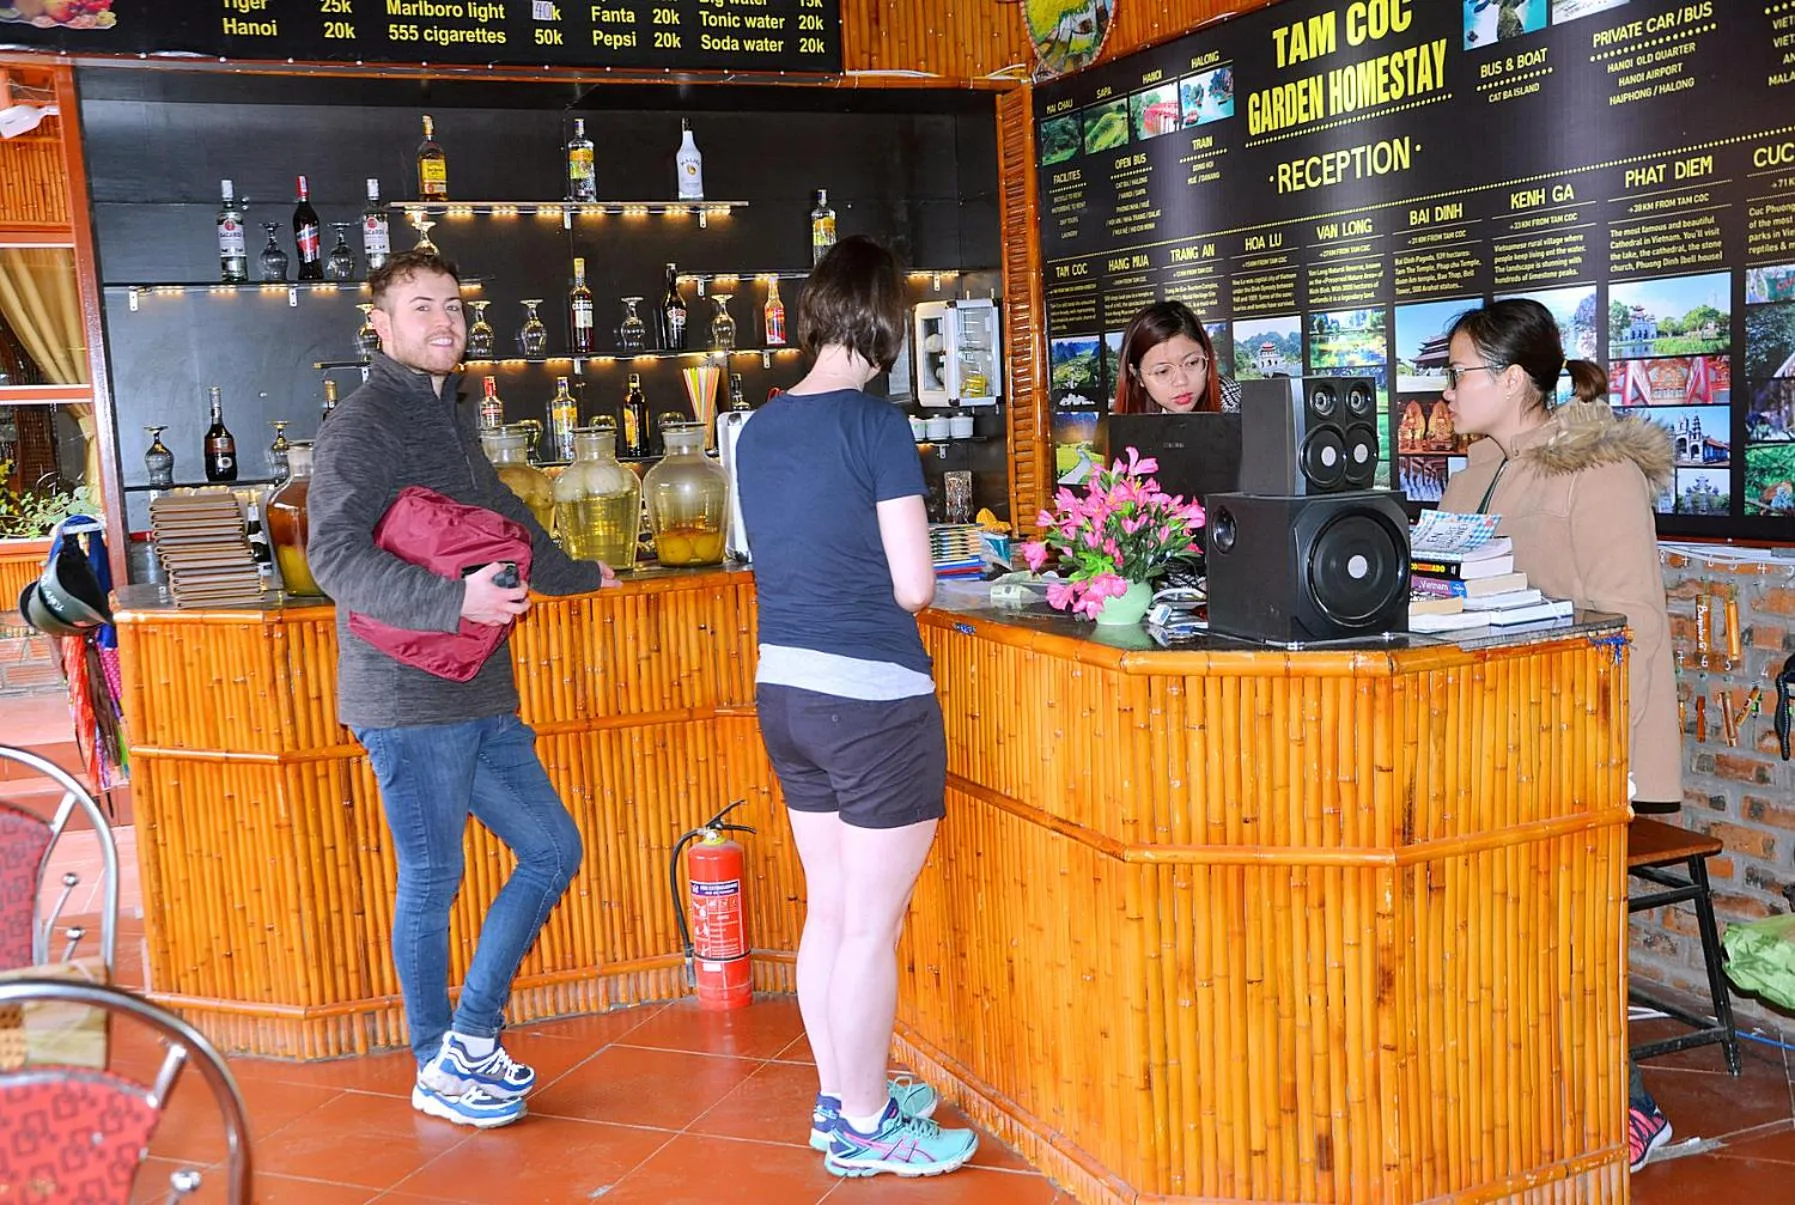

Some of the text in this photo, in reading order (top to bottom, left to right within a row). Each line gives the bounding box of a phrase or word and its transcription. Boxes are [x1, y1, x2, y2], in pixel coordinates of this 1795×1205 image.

[224, 0, 352, 13] Tiger 25k
[387, 0, 464, 18] Marlboro
[467, 2, 505, 21] light
[591, 6, 680, 25] Fanta 20k
[222, 17, 356, 39] Hanoi 20k
[700, 11, 824, 31] Tonic water 20k
[1592, 21, 1643, 48] PRIVATE
[1646, 12, 1674, 36] CAR
[1684, 1, 1713, 23] BUS
[388, 25, 564, 46] 555 cigarettes 50k
[592, 30, 681, 50] Pepsi 20k
[700, 35, 825, 53] Soda water 20k
[1272, 0, 1413, 69] TAM COC
[1480, 48, 1548, 79] BUS & BOAT
[1607, 42, 1697, 74] HANOI OLD QUARTER
[1618, 62, 1684, 87] HANOI AIRPORT
[1248, 38, 1448, 136] GARDEN HOMESTAY
[1488, 82, 1540, 103] CAT BA ISLAND
[1609, 86, 1653, 106] HAIPHONG
[1658, 77, 1695, 95] HALONG
[1192, 136, 1213, 150] TRAIN
[1115, 153, 1147, 170] OPEN BUS
[1277, 136, 1411, 194] RECEPTION
[1753, 142, 1795, 168] CUC
[1625, 155, 1713, 188] PHAT DIEM
[1510, 184, 1575, 209] KENH GA
[1654, 199, 1676, 209] FROM
[1677, 196, 1693, 206] TAM
[1694, 193, 1710, 203] COC
[1409, 202, 1463, 226] BAI DINH
[1531, 219, 1549, 228] FROM
[1564, 212, 1578, 222] COC
[1749, 207, 1764, 216] Cuc
[1749, 215, 1794, 229] of the most
[1316, 218, 1373, 240] VAN LONG
[1610, 215, 1715, 238] The most famous and beautiful
[1748, 232, 1772, 243] parks
[1773, 229, 1781, 239] in
[1245, 232, 1282, 251] HOA LU
[1610, 238, 1643, 250] Cathedral
[1643, 237, 1651, 245] in
[1704, 227, 1720, 237] visit
[1639, 248, 1650, 258] the
[1688, 242, 1700, 251] the
[1701, 240, 1722, 249] stone
[1748, 241, 1787, 255] reptiles &
[1108, 254, 1149, 272] HANG MUA
[1170, 244, 1215, 262] TRANG AN
[1056, 263, 1088, 278] TAM COC
